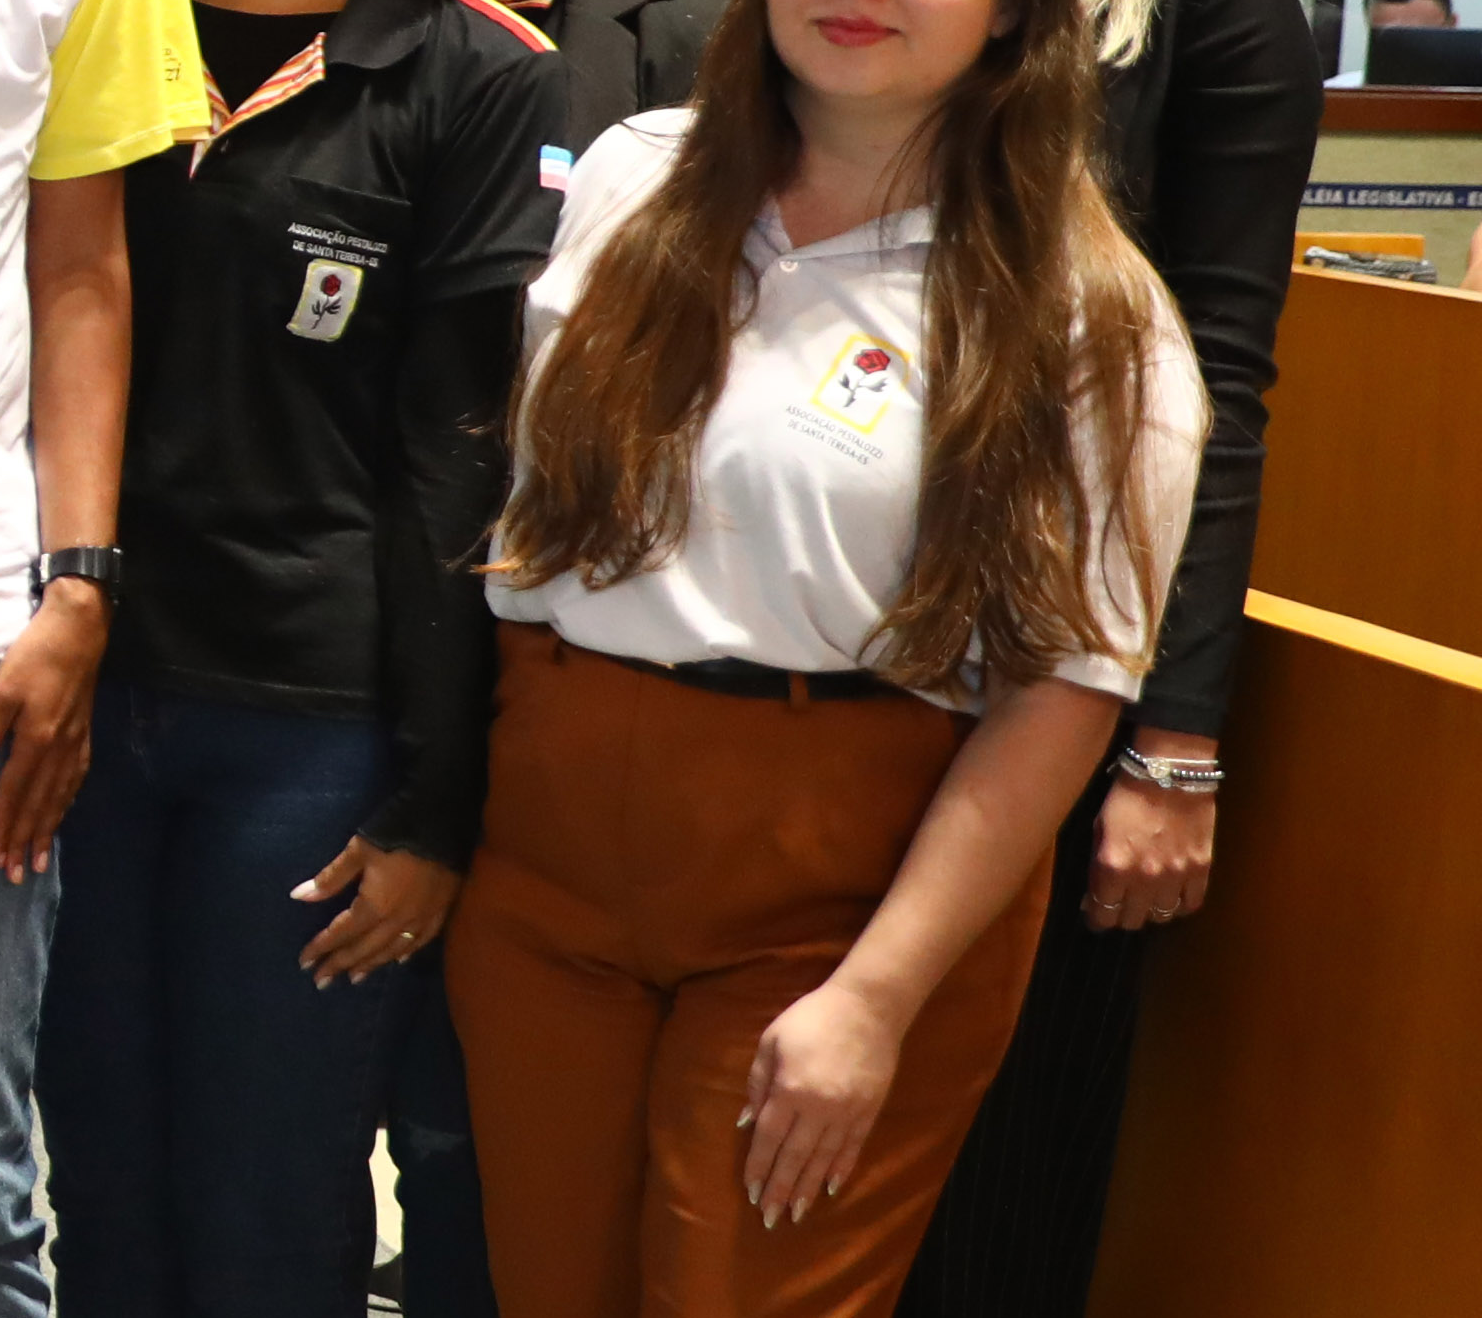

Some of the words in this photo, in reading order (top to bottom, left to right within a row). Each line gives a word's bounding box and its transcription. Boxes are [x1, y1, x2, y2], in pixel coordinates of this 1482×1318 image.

[1347, 189, 1455, 205] LEGISLATIVA
[287, 222, 346, 244] ASSOCIAÇÃO
[292, 240, 305, 252] DE
[786, 405, 836, 432] ASSOCIAÇÃO
[838, 427, 884, 459] PESTALOZZI
[787, 419, 798, 430] DE
[800, 424, 825, 442] SANTA
